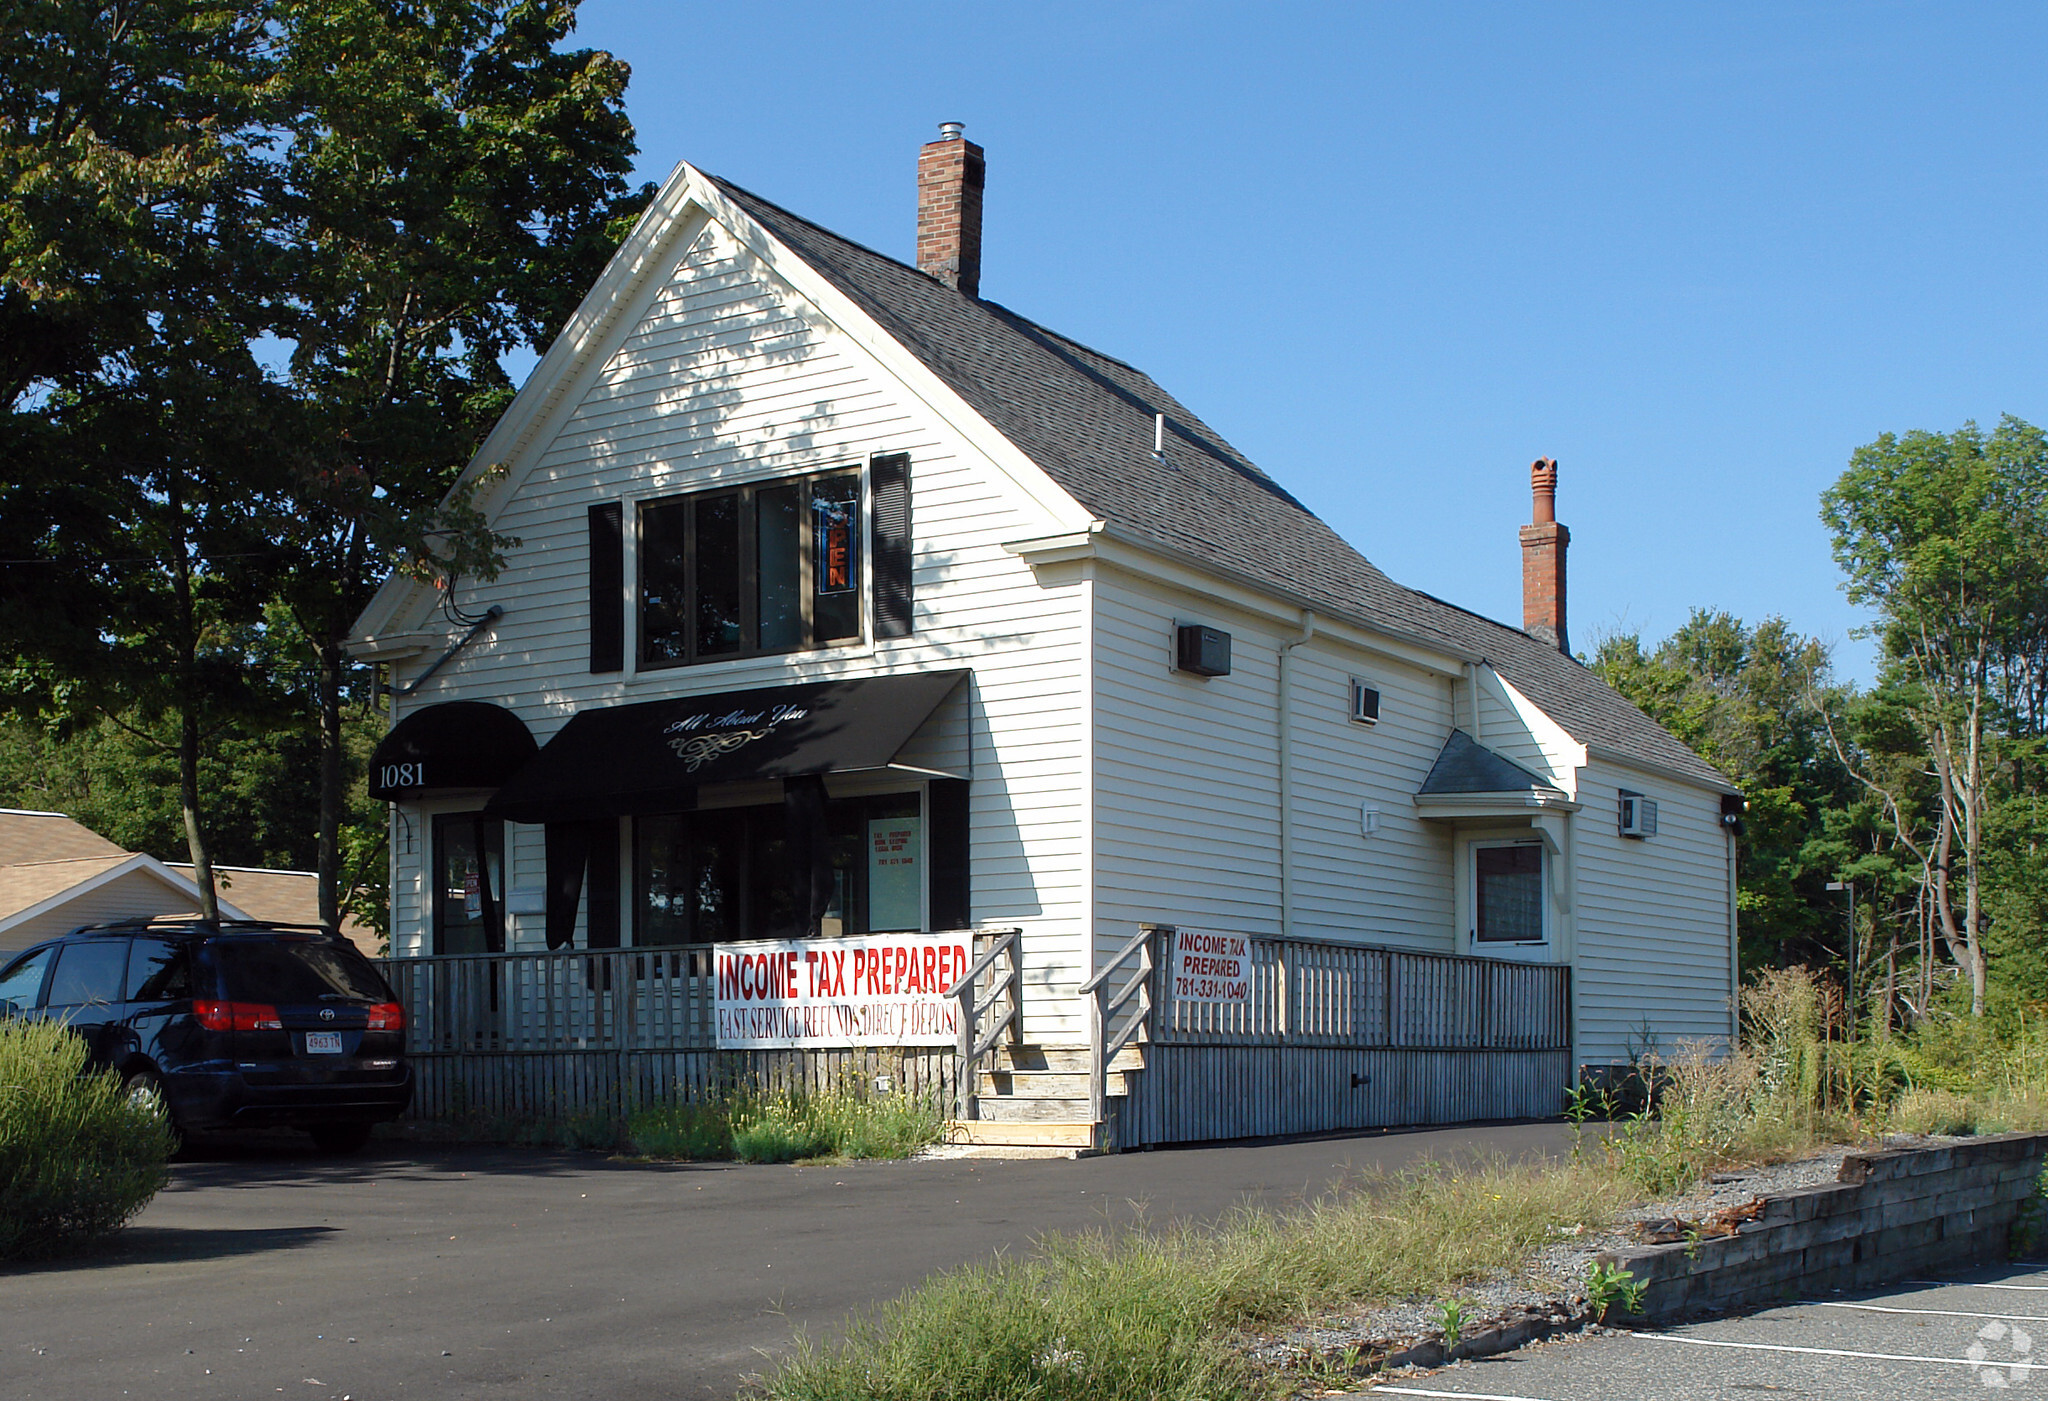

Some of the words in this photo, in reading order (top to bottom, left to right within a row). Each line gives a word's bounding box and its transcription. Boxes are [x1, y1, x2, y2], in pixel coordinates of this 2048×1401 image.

[663, 713, 709, 734] All
[705, 709, 766, 728] About
[768, 704, 808, 727] You
[380, 762, 425, 788] 1081
[1179, 932, 1228, 955] INCOME
[1229, 939, 1246, 957] TAX
[719, 952, 798, 1001] INCOME
[805, 950, 846, 997] TAX
[853, 945, 966, 996] PREPARED
[1183, 956, 1240, 978] PREPARED
[1176, 977, 1247, 999] 781-331-1040
[719, 1008, 747, 1040] FAST
[751, 1006, 801, 1040] SERVICE
[804, 1004, 860, 1038] REFUNDS
[863, 1003, 907, 1036] DIRECT
[911, 1002, 958, 1036] DEPOSI
